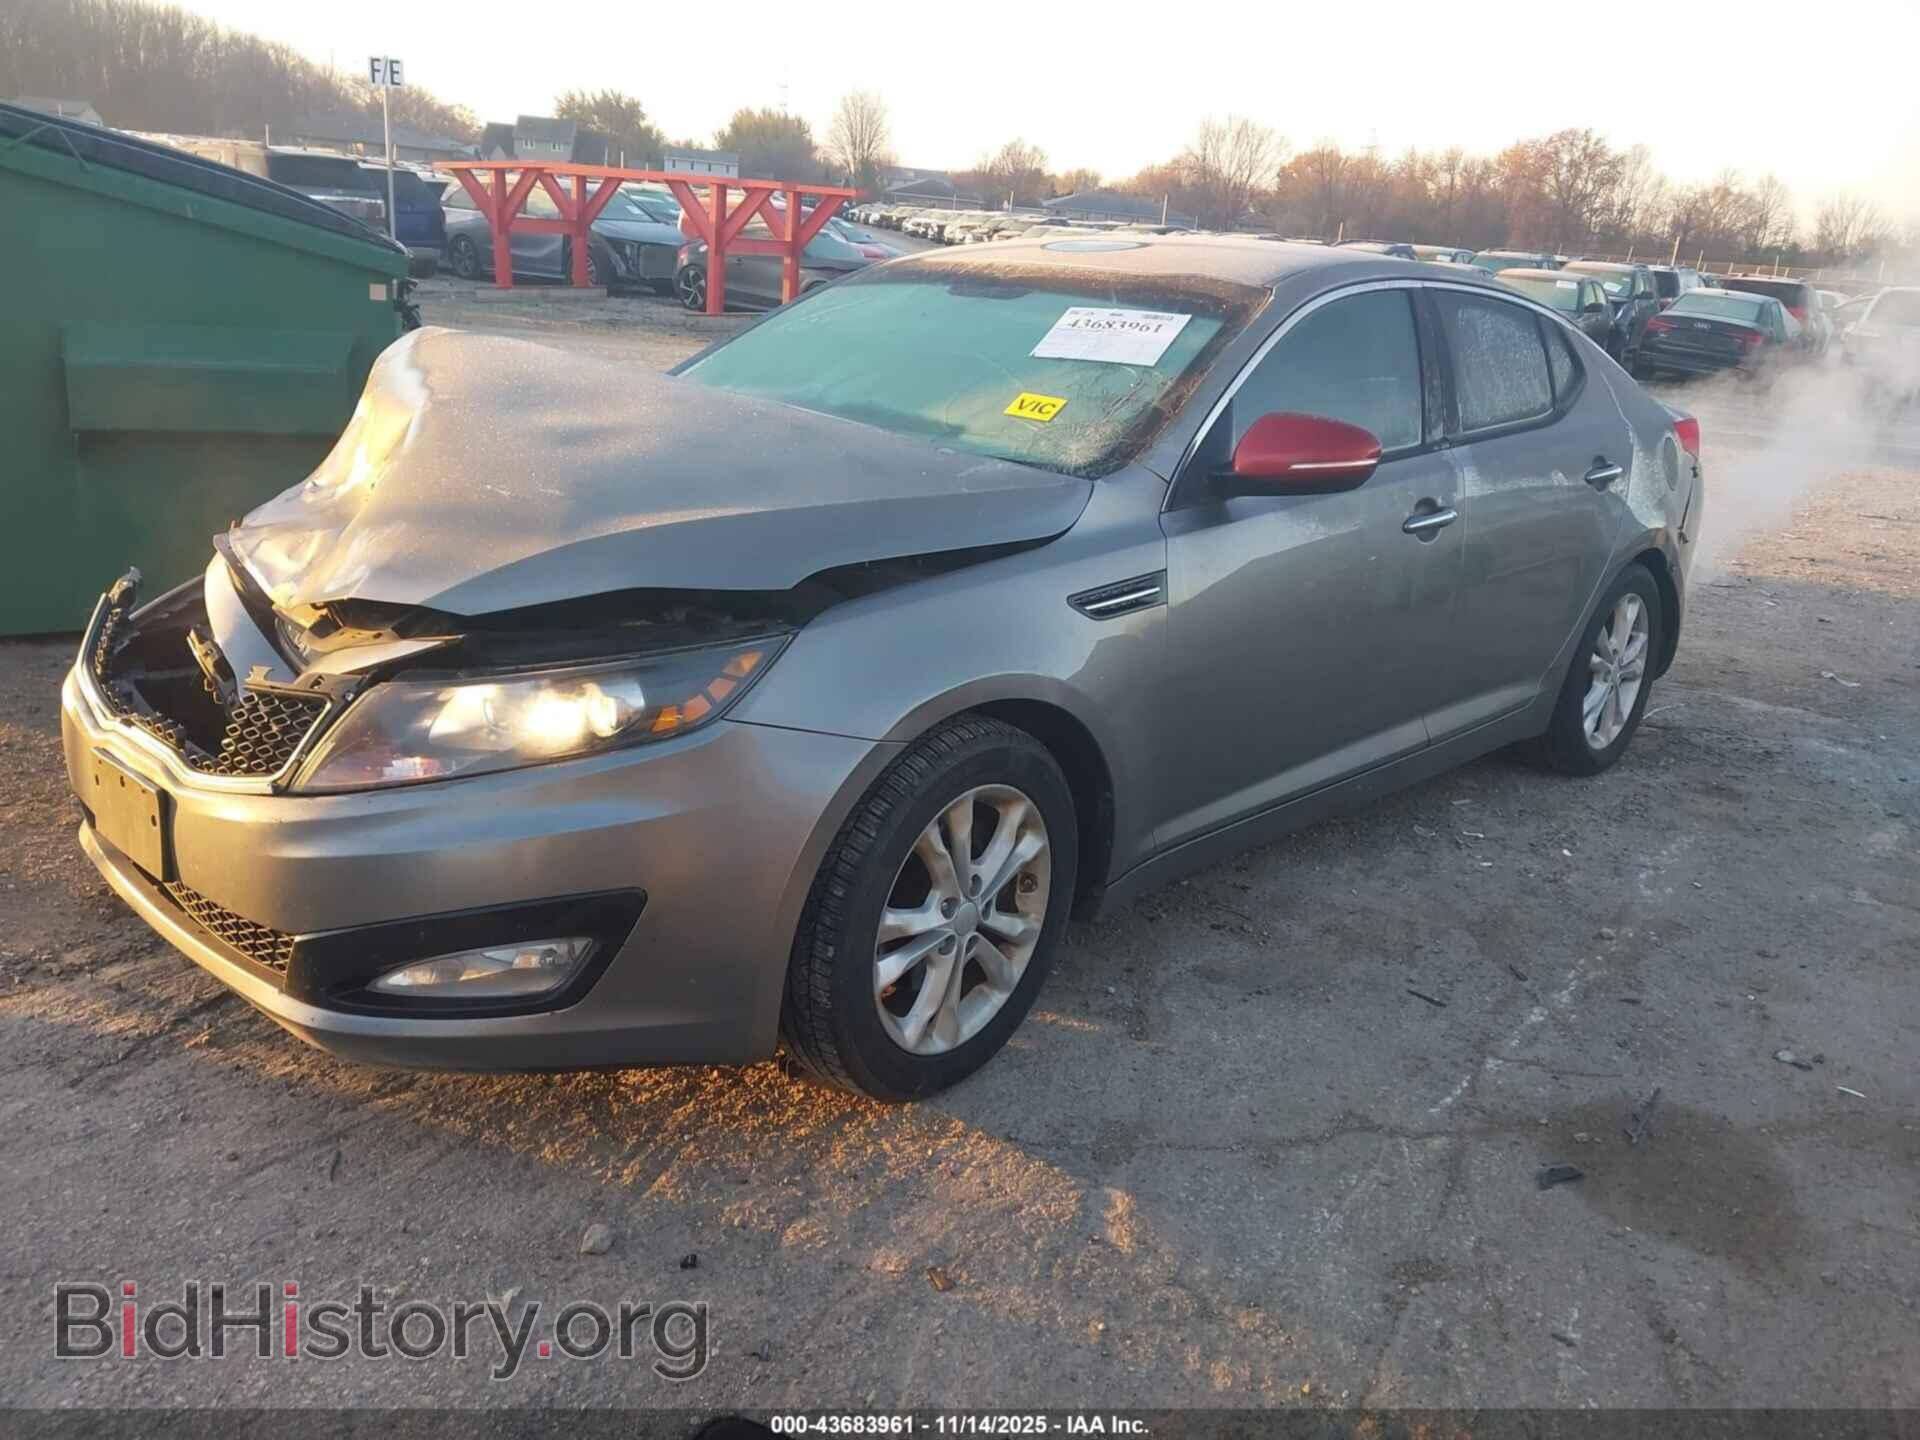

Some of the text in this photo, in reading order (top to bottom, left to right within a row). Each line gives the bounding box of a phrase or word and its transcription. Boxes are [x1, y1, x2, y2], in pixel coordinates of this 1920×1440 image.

[370, 56, 401, 86] F/E
[1067, 316, 1164, 334] 43683961
[1016, 398, 1057, 416] VIC
